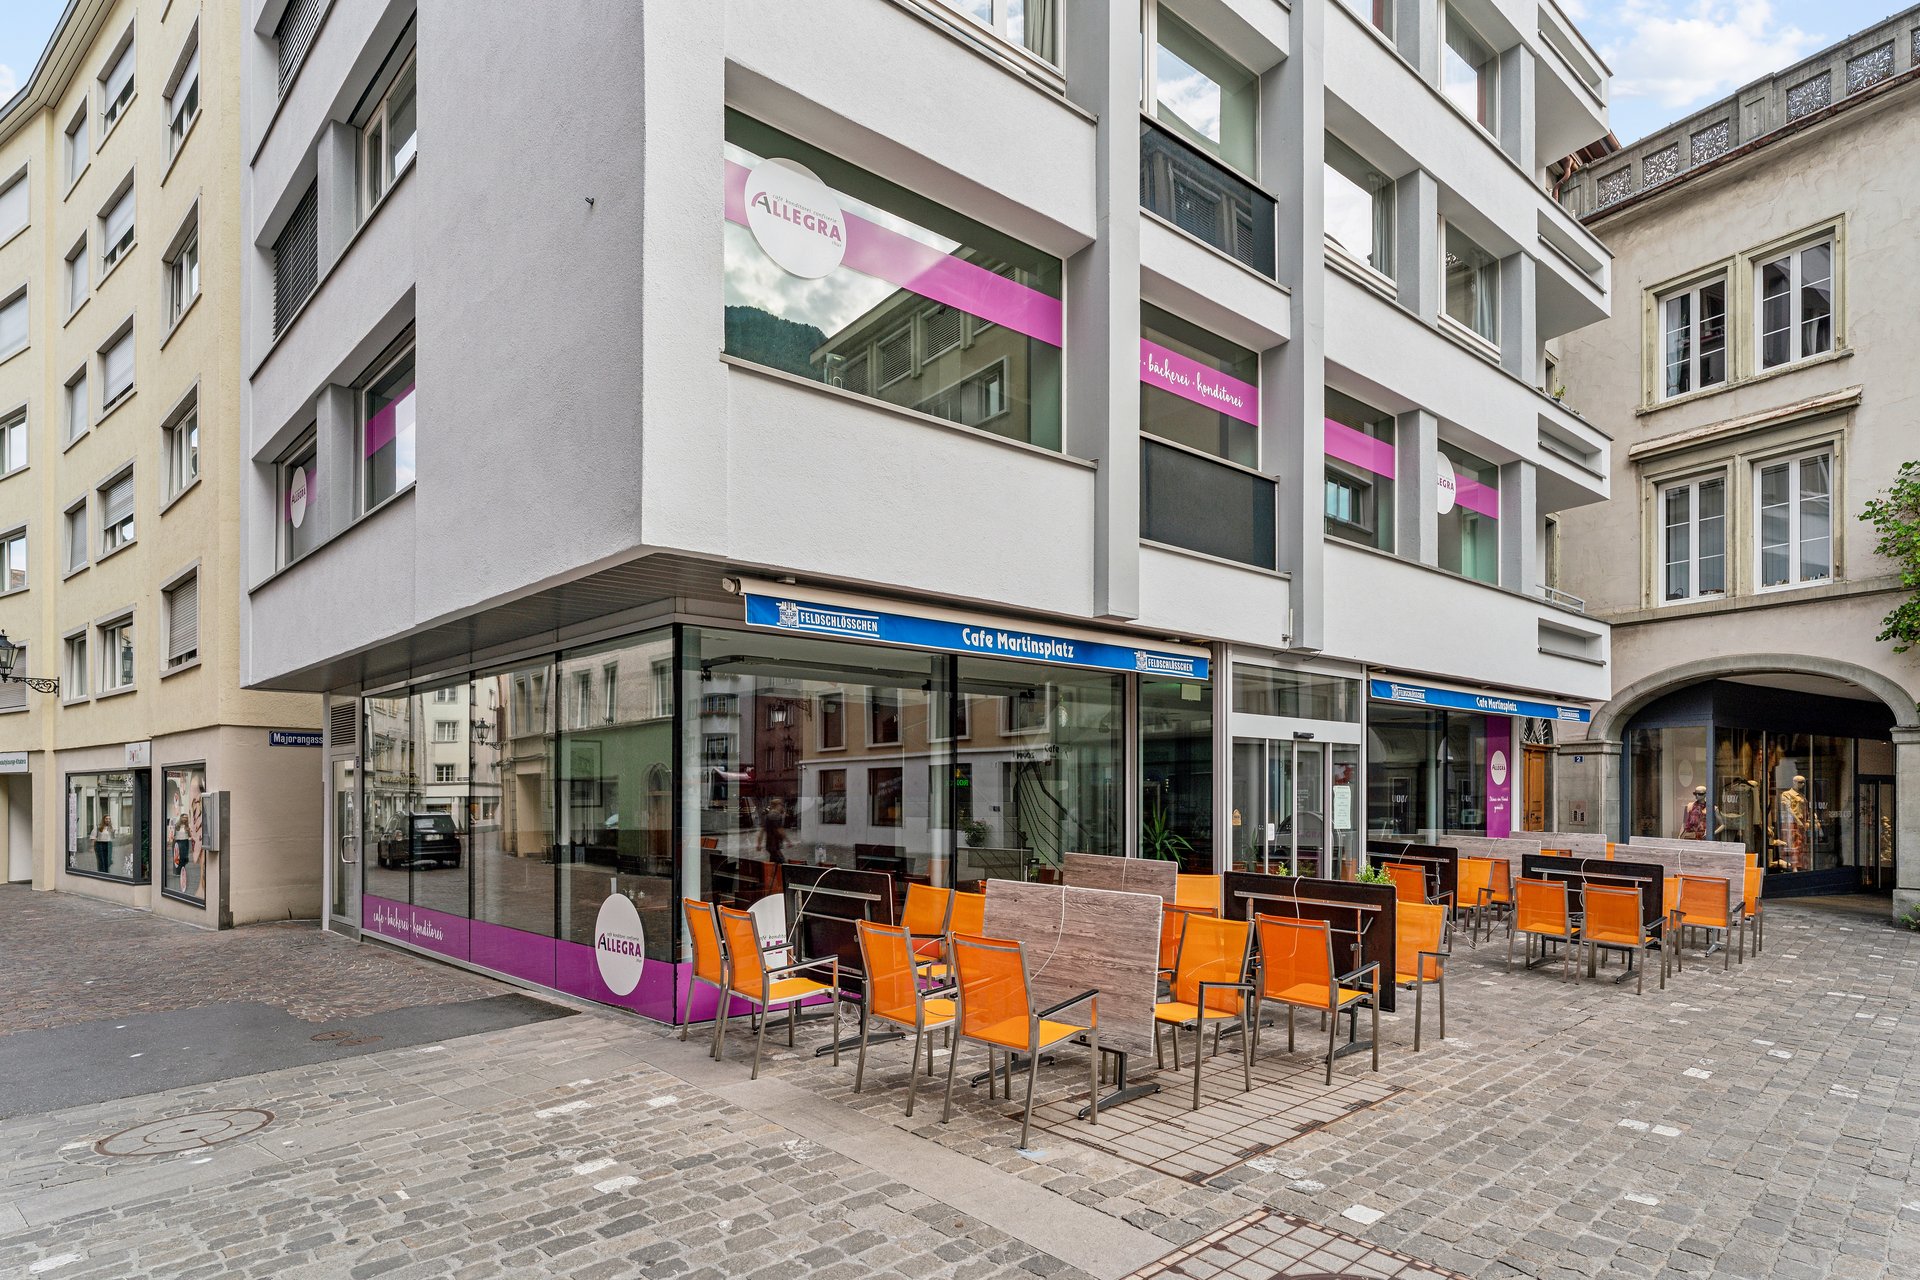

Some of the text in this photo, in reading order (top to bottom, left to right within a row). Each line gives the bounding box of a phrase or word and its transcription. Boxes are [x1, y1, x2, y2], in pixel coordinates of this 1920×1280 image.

[751, 192, 841, 242] ALLEGRA
[1148, 353, 1244, 408] bäckerei konditorei
[800, 611, 878, 632] FELDSCHLÖSSCHEN
[962, 628, 1074, 660] Cafe Martinsplatz
[412, 911, 444, 941] konditorei
[597, 933, 642, 958] ALLEGRA
